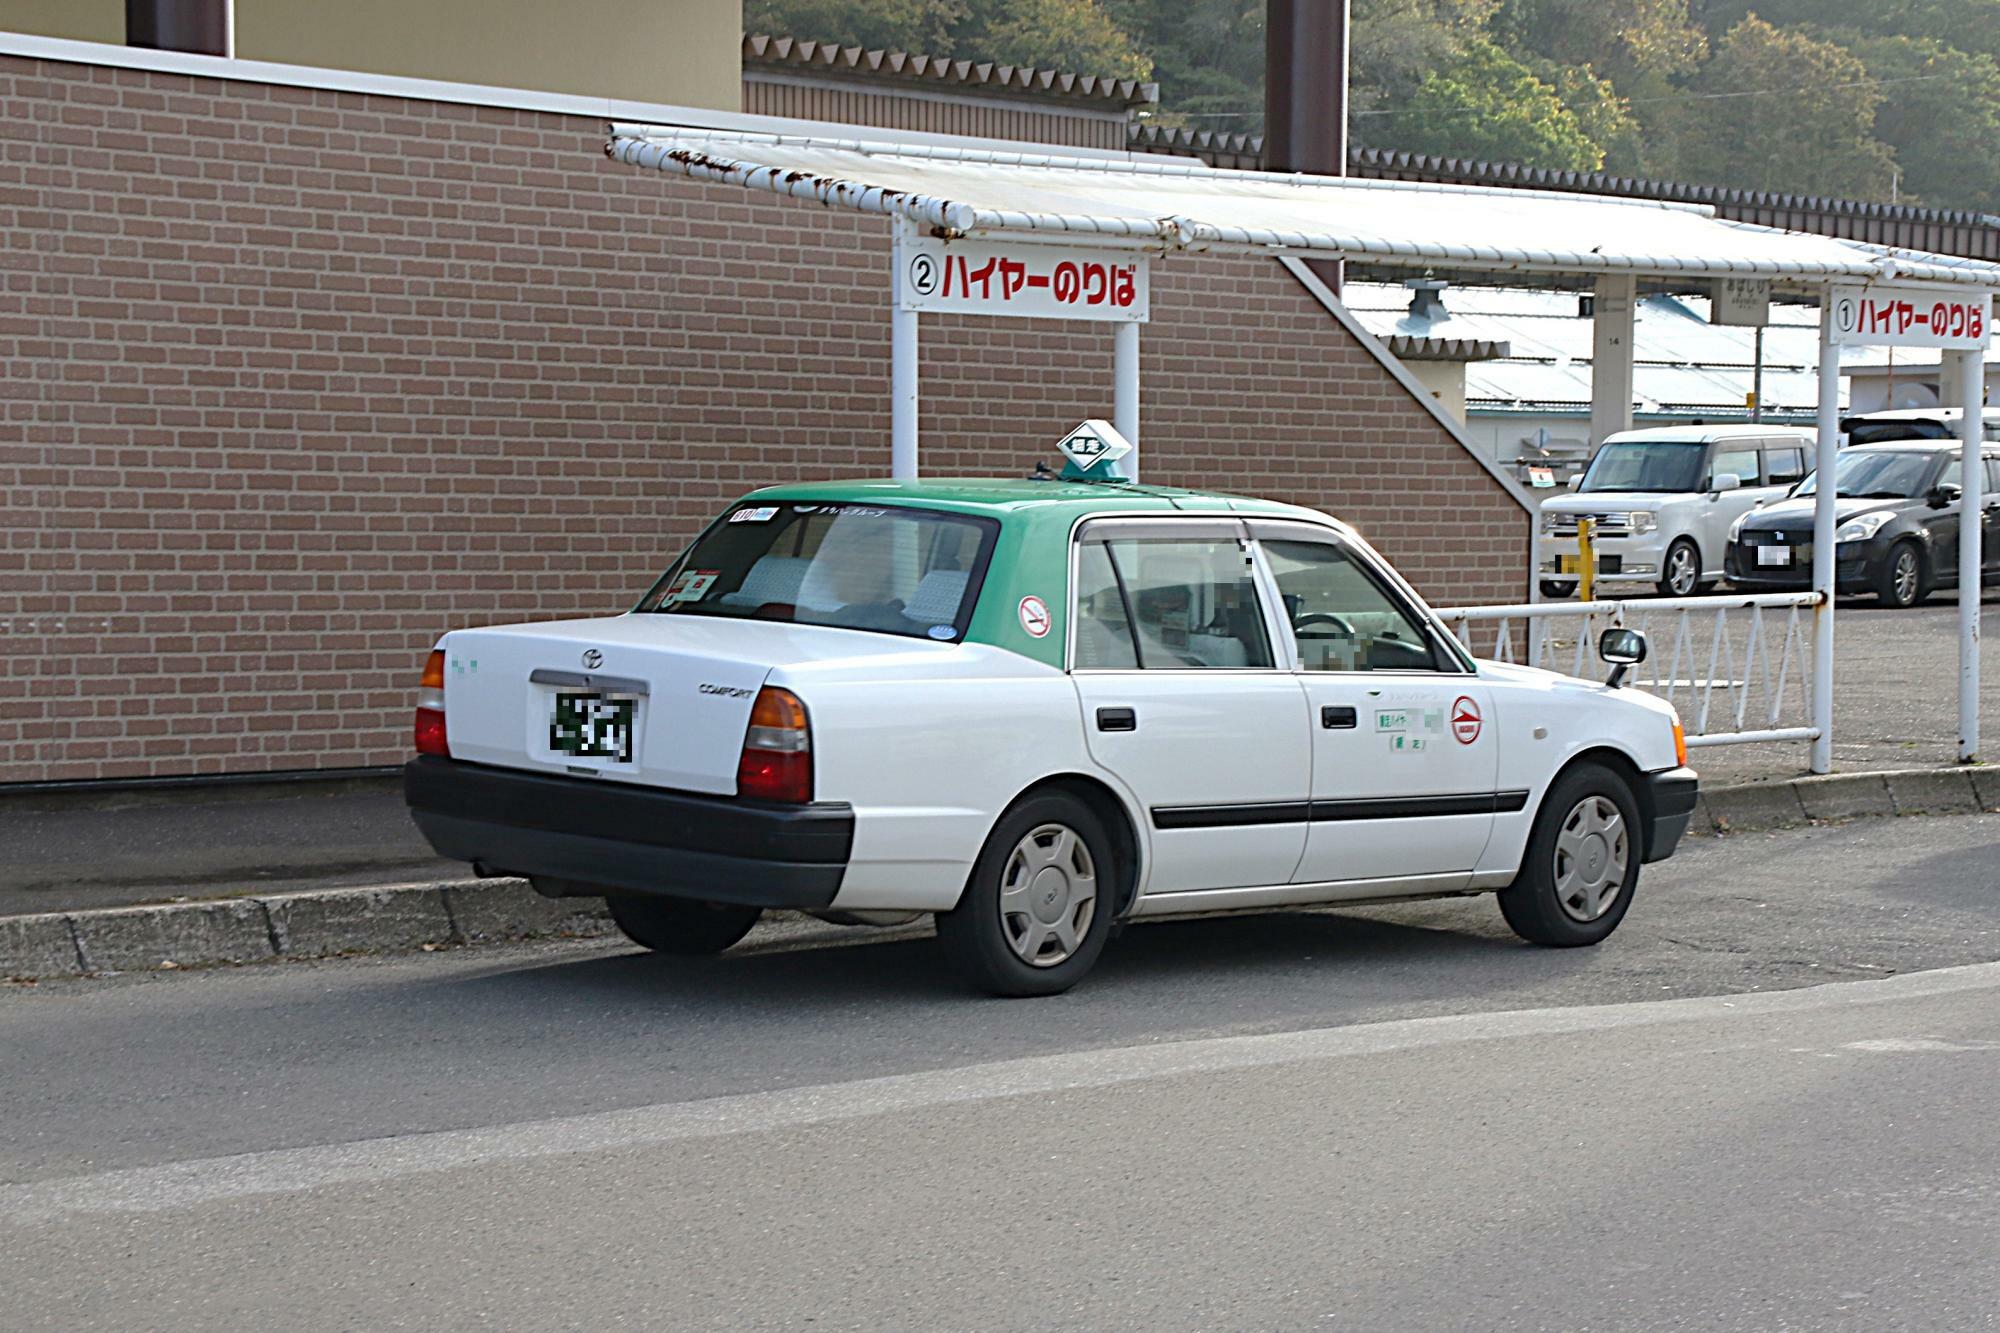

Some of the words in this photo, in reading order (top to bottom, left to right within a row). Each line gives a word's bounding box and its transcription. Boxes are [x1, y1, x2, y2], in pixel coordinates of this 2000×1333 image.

[941, 255, 1136, 307] ハイヤーのりば
[1857, 299, 1984, 338] ハイヤーのりば
[698, 683, 755, 699] COMFORT
